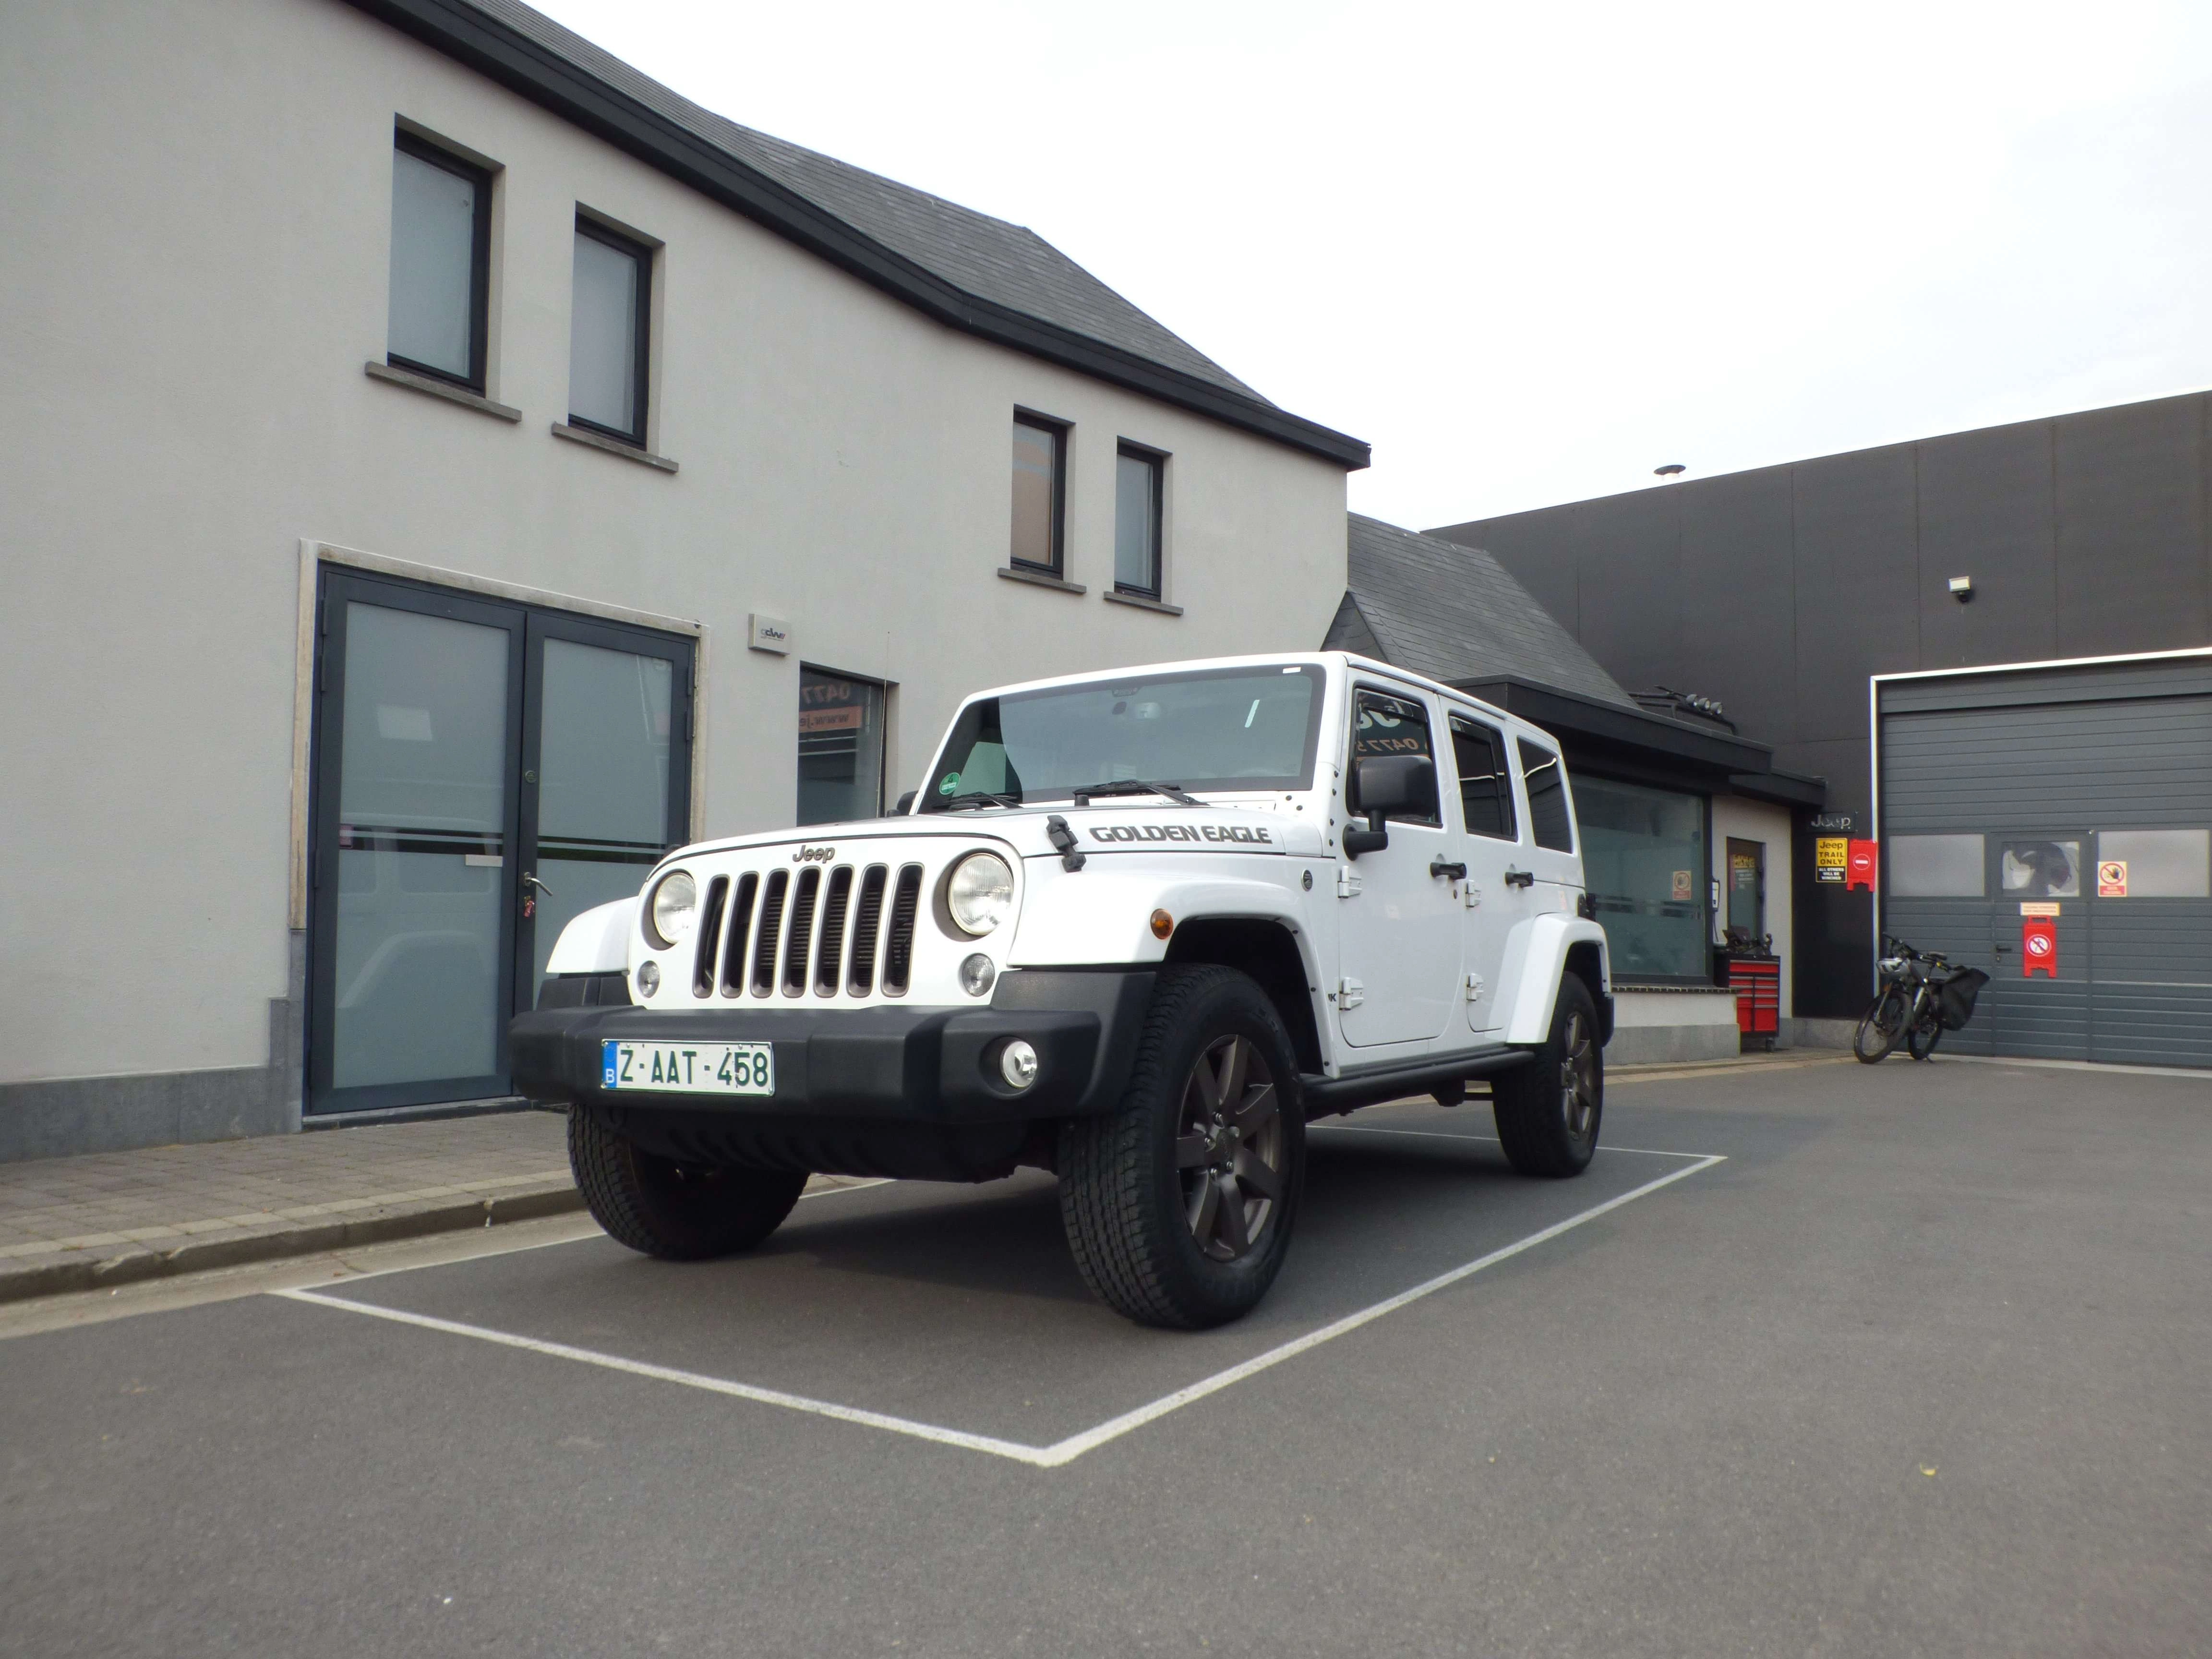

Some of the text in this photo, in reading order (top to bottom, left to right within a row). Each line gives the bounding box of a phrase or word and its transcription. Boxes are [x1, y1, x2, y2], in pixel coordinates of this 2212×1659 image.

[1089, 825, 1274, 845] GOLDEN EAGLE
[792, 844, 836, 864] Jeep
[1820, 842, 1843, 850] Jeep
[606, 1069, 615, 1084] B
